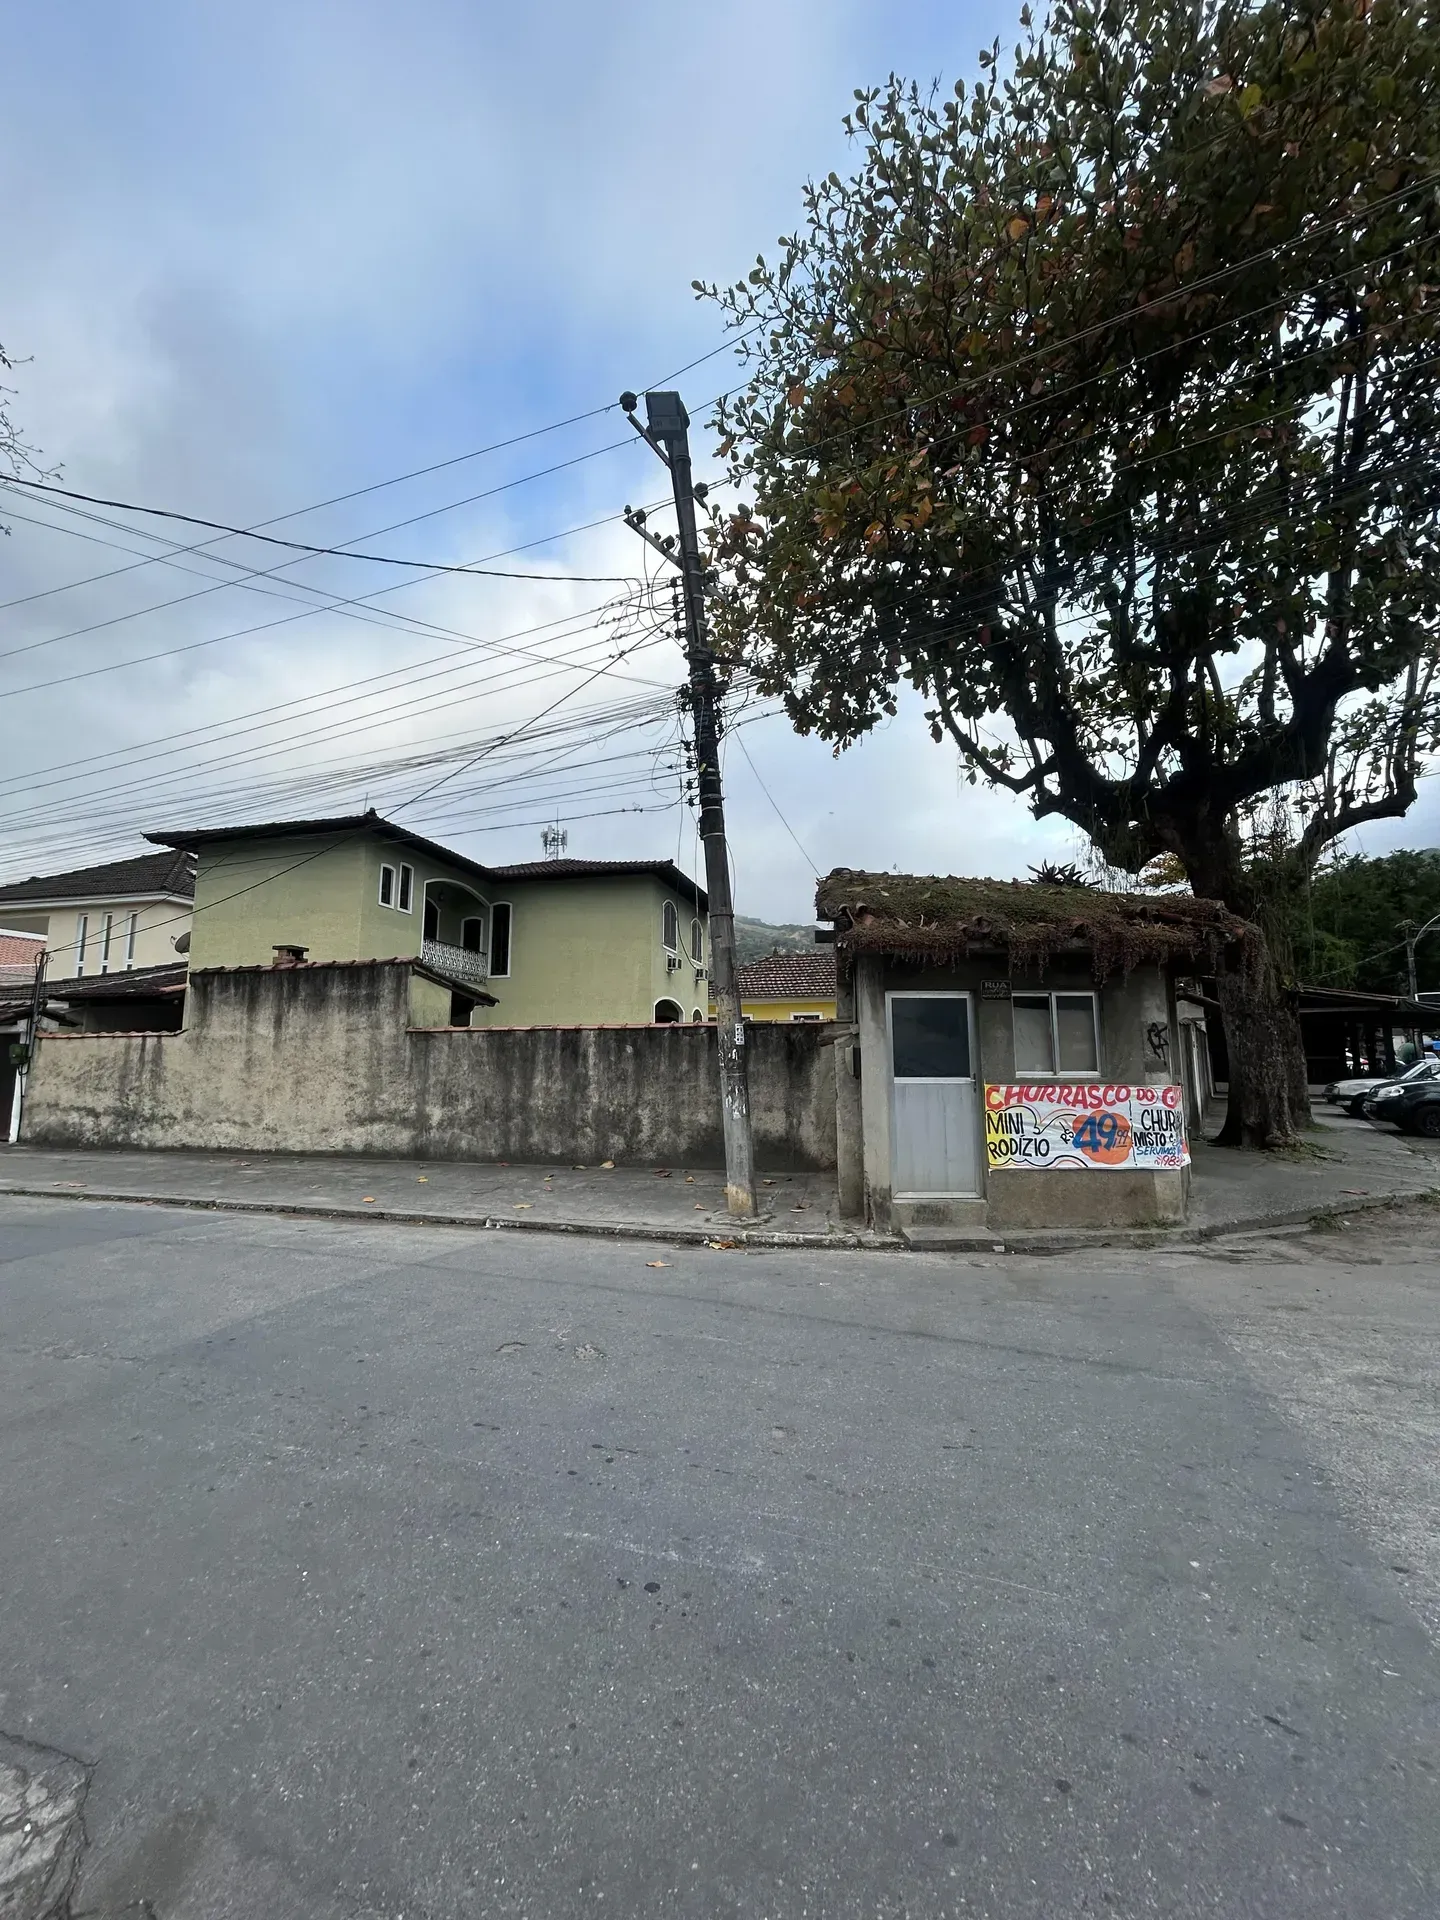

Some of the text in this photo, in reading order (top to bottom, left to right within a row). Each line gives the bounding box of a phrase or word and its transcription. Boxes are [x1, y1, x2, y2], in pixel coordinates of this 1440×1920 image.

[986, 1085, 1131, 1110] CHURRASCO
[1136, 1088, 1156, 1102] DO
[987, 1112, 1025, 1134] MINI
[988, 1135, 1050, 1159] RODÍZIO
[1133, 1132, 1166, 1147] MISTO
